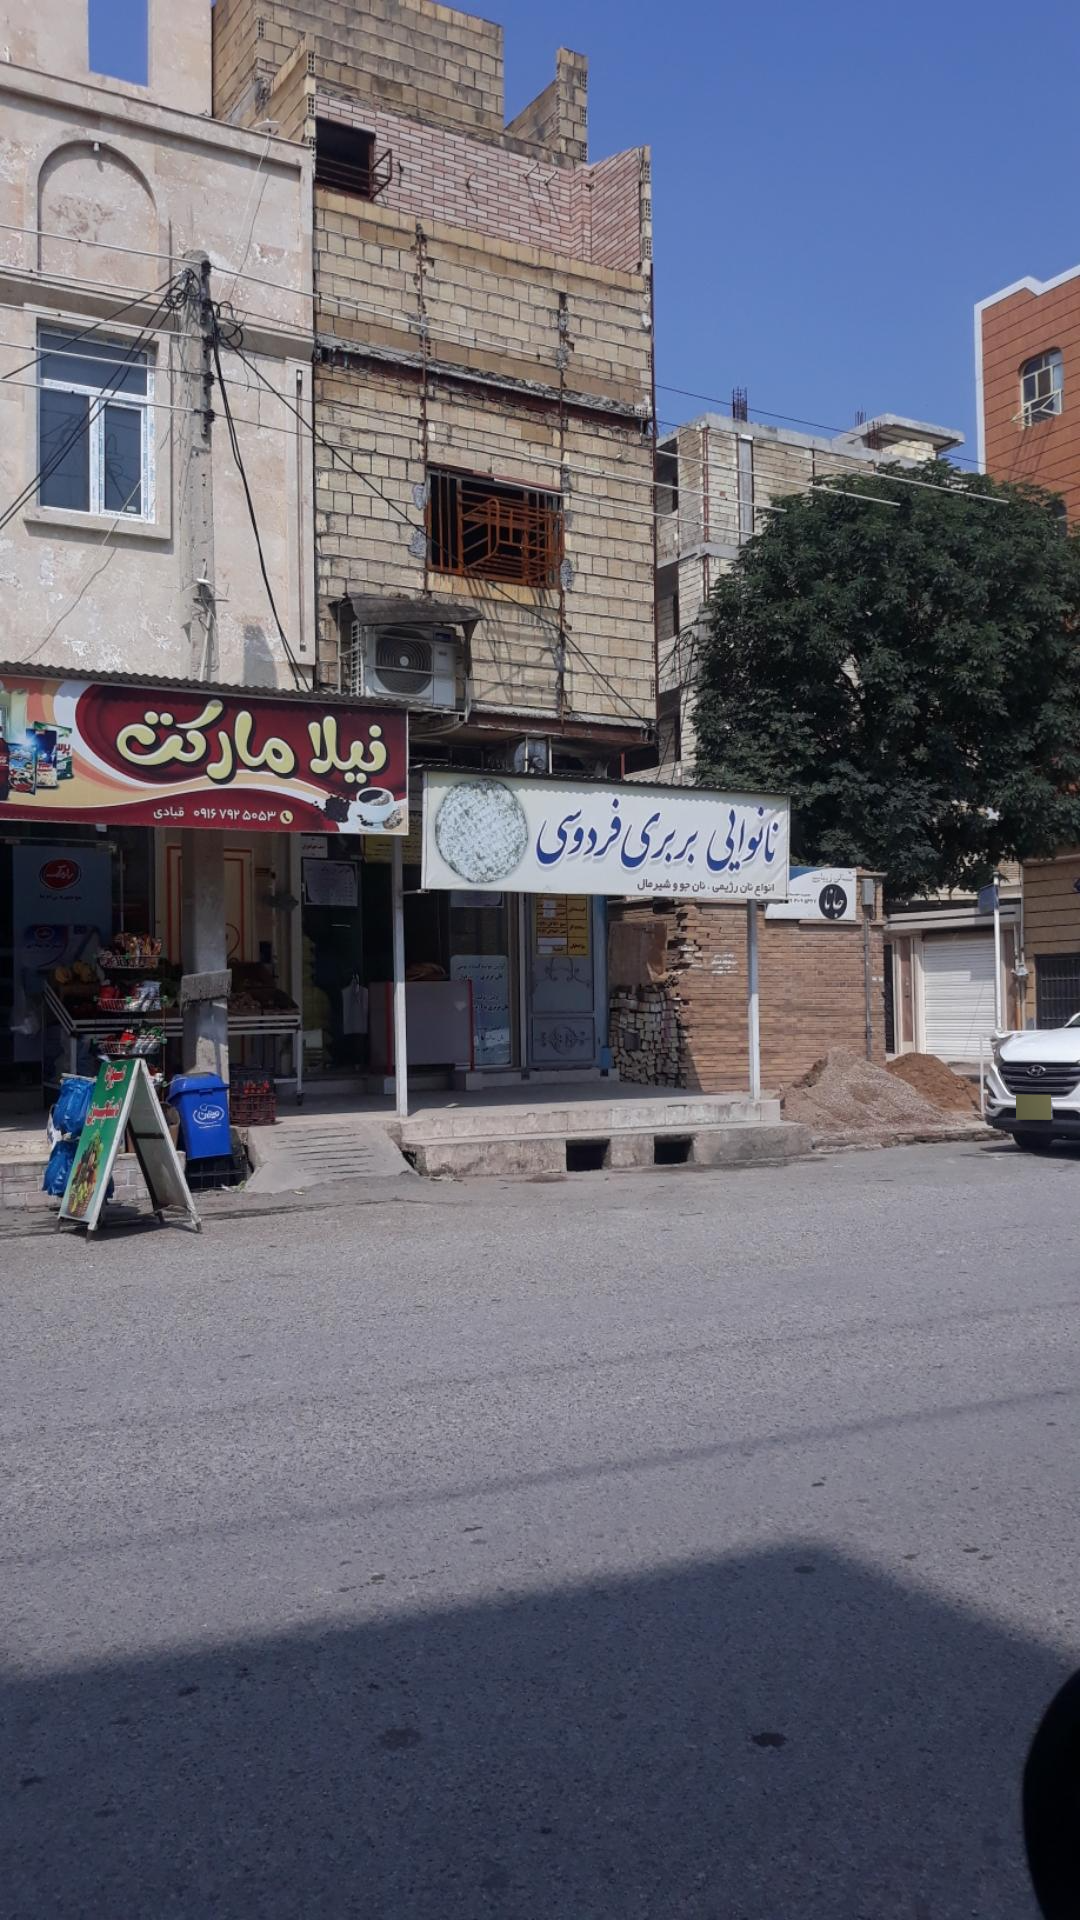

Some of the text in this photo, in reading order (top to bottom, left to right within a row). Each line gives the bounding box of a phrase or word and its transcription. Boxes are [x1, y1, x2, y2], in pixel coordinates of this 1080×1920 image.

[116, 699, 387, 784] نیلا مارکت
[153, 806, 277, 821] ۰۹۱۶ ۷۹۲ ۵۰۵۳ قبادی
[536, 798, 779, 872] نانوایی بربری فردوسی
[679, 881, 690, 892] جو
[692, 880, 706, 892] نان
[712, 881, 739, 894] رژیمی
[740, 882, 753, 894] نان
[754, 883, 775, 897] انواع
